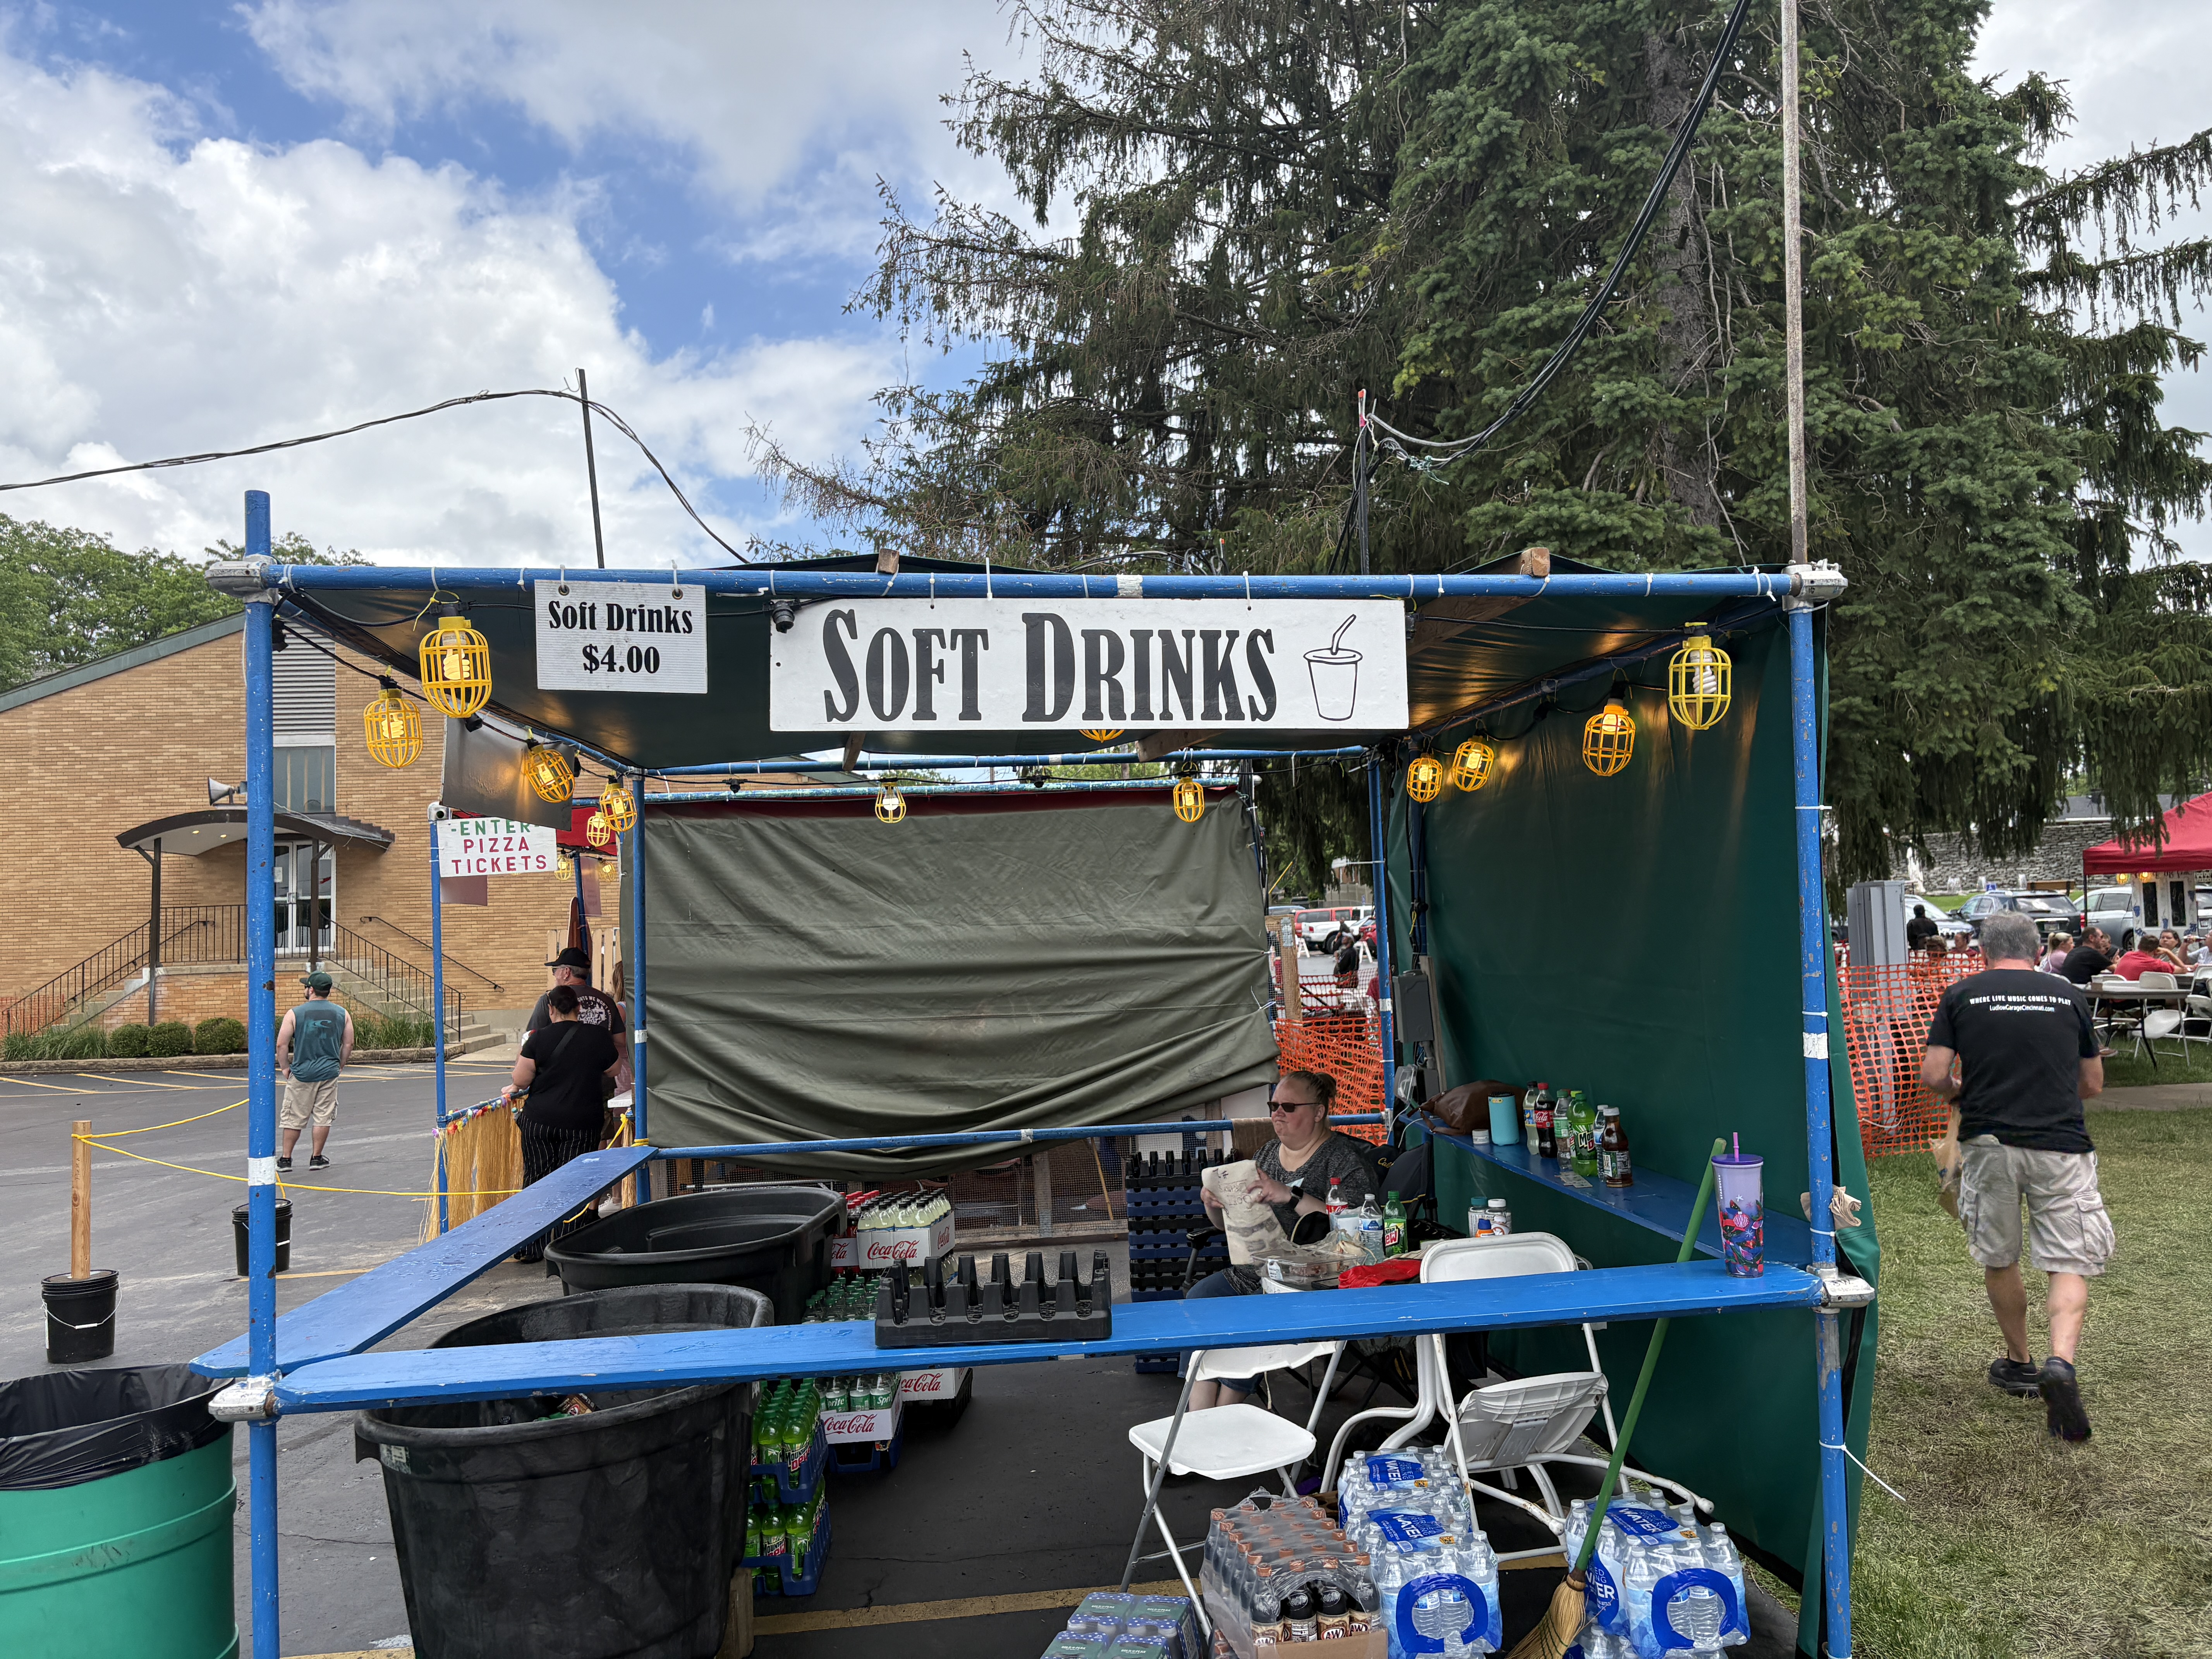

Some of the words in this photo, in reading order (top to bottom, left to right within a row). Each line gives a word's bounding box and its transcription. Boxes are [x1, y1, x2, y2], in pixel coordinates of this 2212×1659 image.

[548, 600, 597, 630] Soft
[606, 603, 693, 634] Drinks
[582, 643, 660, 674] $4.00
[824, 609, 989, 723] SOFT
[1022, 612, 1278, 723] DRINKS
[464, 836, 529, 854] PIZZA
[451, 855, 547, 874] TICKETS
[1970, 996, 1990, 1005] WHERE
[2058, 997, 2071, 1006] PLAY
[867, 1240, 920, 1260] Coca-Cola
[1385, 1460, 1402, 1482] WATER
[1619, 1508, 1663, 1533] WATER
